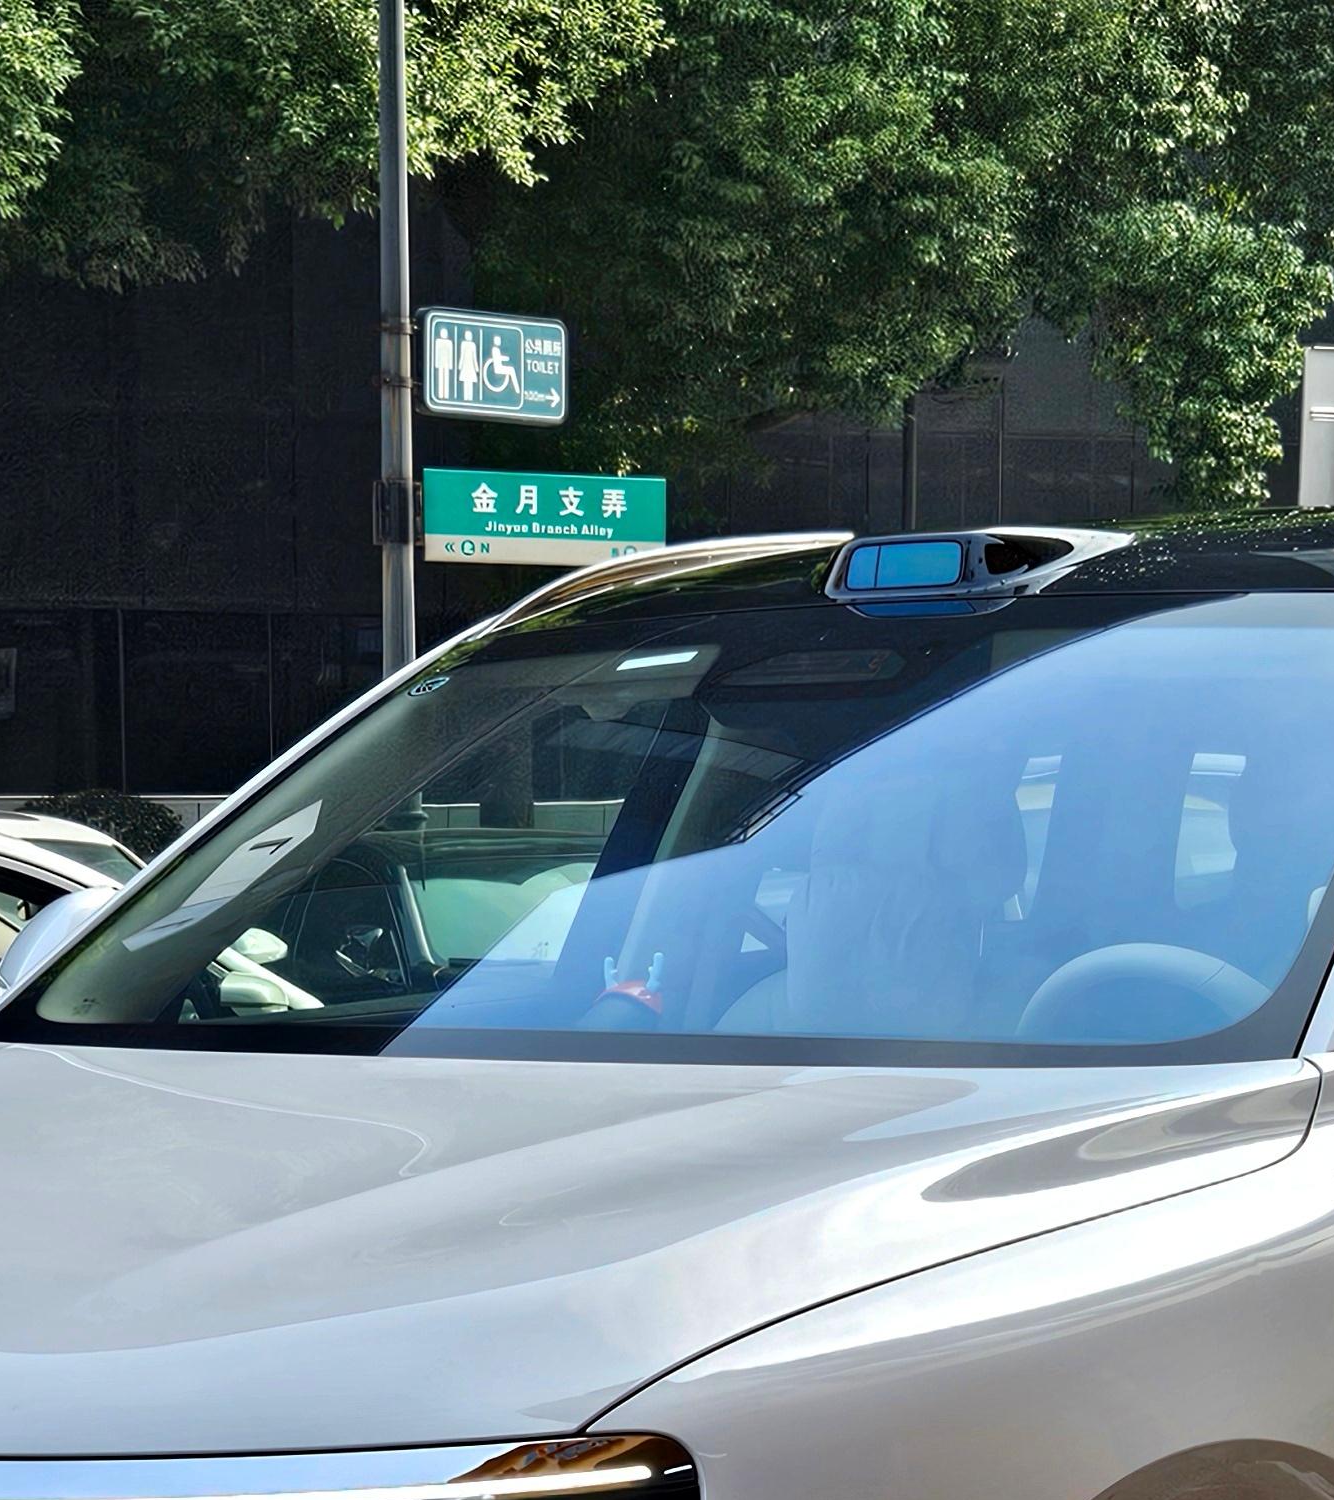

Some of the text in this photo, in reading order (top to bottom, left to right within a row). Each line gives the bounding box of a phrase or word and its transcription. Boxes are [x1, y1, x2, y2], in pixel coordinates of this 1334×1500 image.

[526, 360, 560, 375] TOILET
[471, 482, 627, 518] 金月支弄
[485, 521, 614, 539] Jinyue Branch Alley
[480, 543, 490, 553] N
